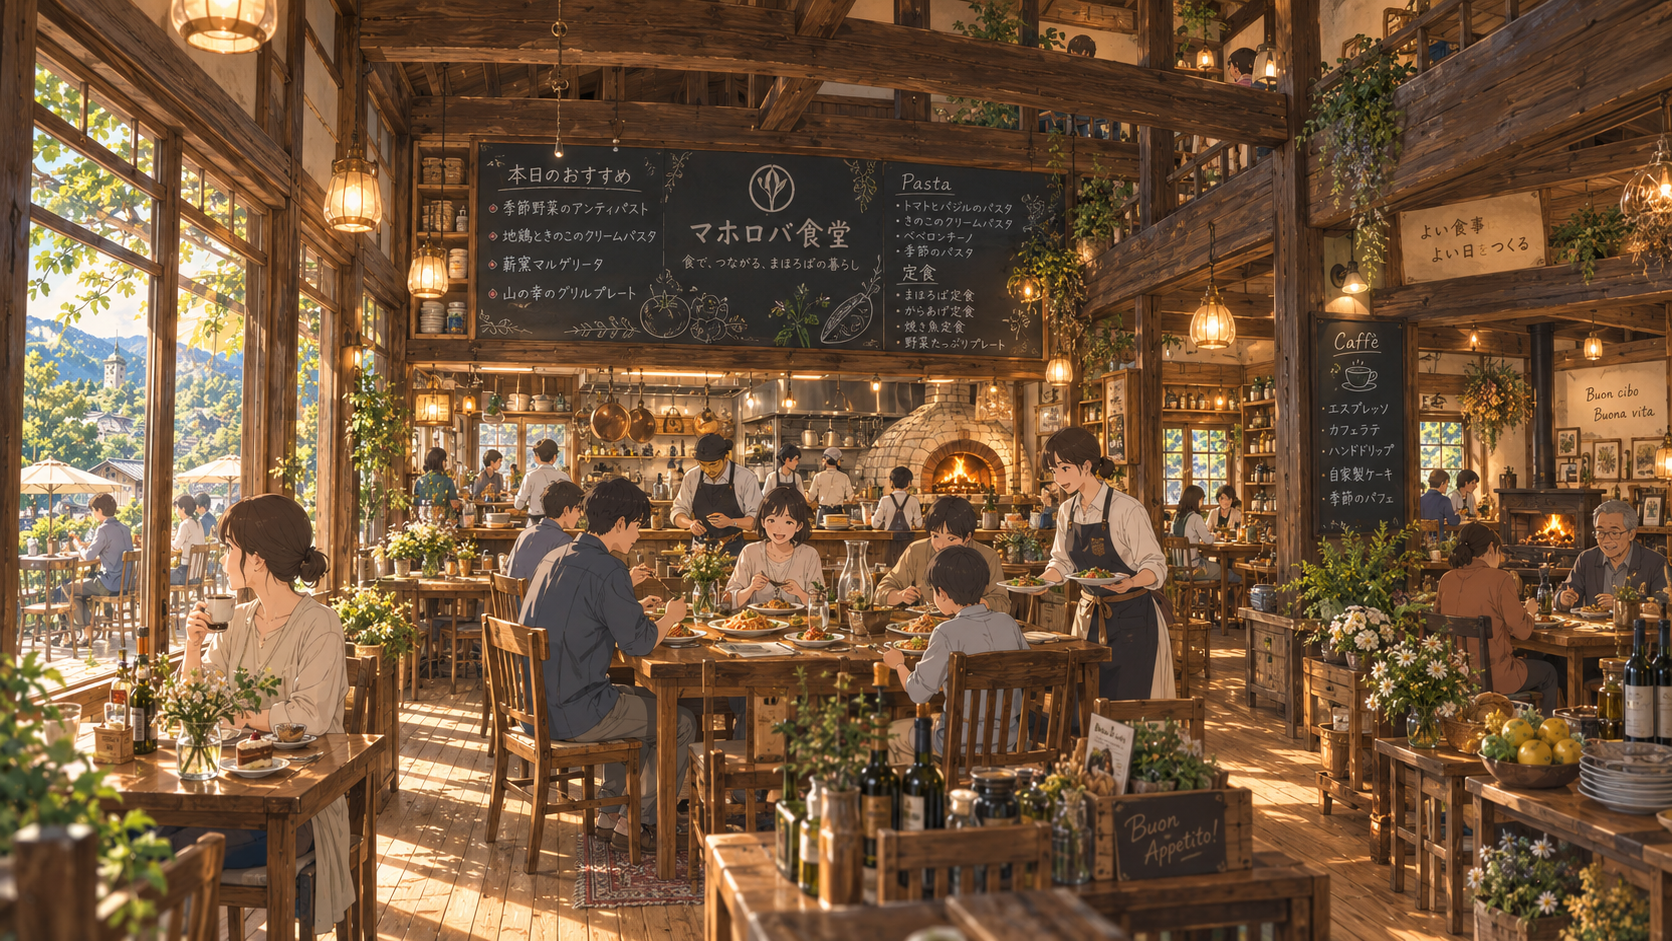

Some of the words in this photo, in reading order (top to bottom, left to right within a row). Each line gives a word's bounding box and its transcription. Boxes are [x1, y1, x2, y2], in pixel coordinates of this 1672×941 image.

[507, 163, 631, 185] 本日のおすすめ
[901, 172, 952, 191] Pasta
[502, 199, 649, 217] 季節野菜のアンティパスト
[904, 200, 1013, 215] トマトとバジルのパスタ
[904, 215, 1013, 230] きのこのクリームパスタ
[1420, 215, 1499, 240] よい食事
[501, 227, 657, 244] 地鶏ときのこのクリームパスタ
[689, 217, 851, 249] マホロバ食堂
[904, 244, 974, 259] 季節のパスタ
[502, 254, 604, 273] 薪窯マルゲリータ
[902, 263, 937, 282] 定食
[502, 284, 637, 301] 山の幸のグリルプレート
[904, 288, 975, 303] まほろば定食
[904, 319, 966, 335] 焼き魚定食
[904, 335, 1006, 351] 野菜たっぷりプレート
[1585, 386, 1614, 403] Buon
[1617, 383, 1639, 399] cibo
[1593, 407, 1628, 422] Buona
[1631, 405, 1656, 418] vita
[1329, 423, 1381, 436] カフェラテ
[1328, 443, 1395, 457] ハンドドリップ
[1329, 466, 1393, 483] 自家製ケーキ
[1329, 490, 1394, 507] 季節のパフェ
[1124, 813, 1180, 843] Buon
[1144, 818, 1218, 867] Appetito!
